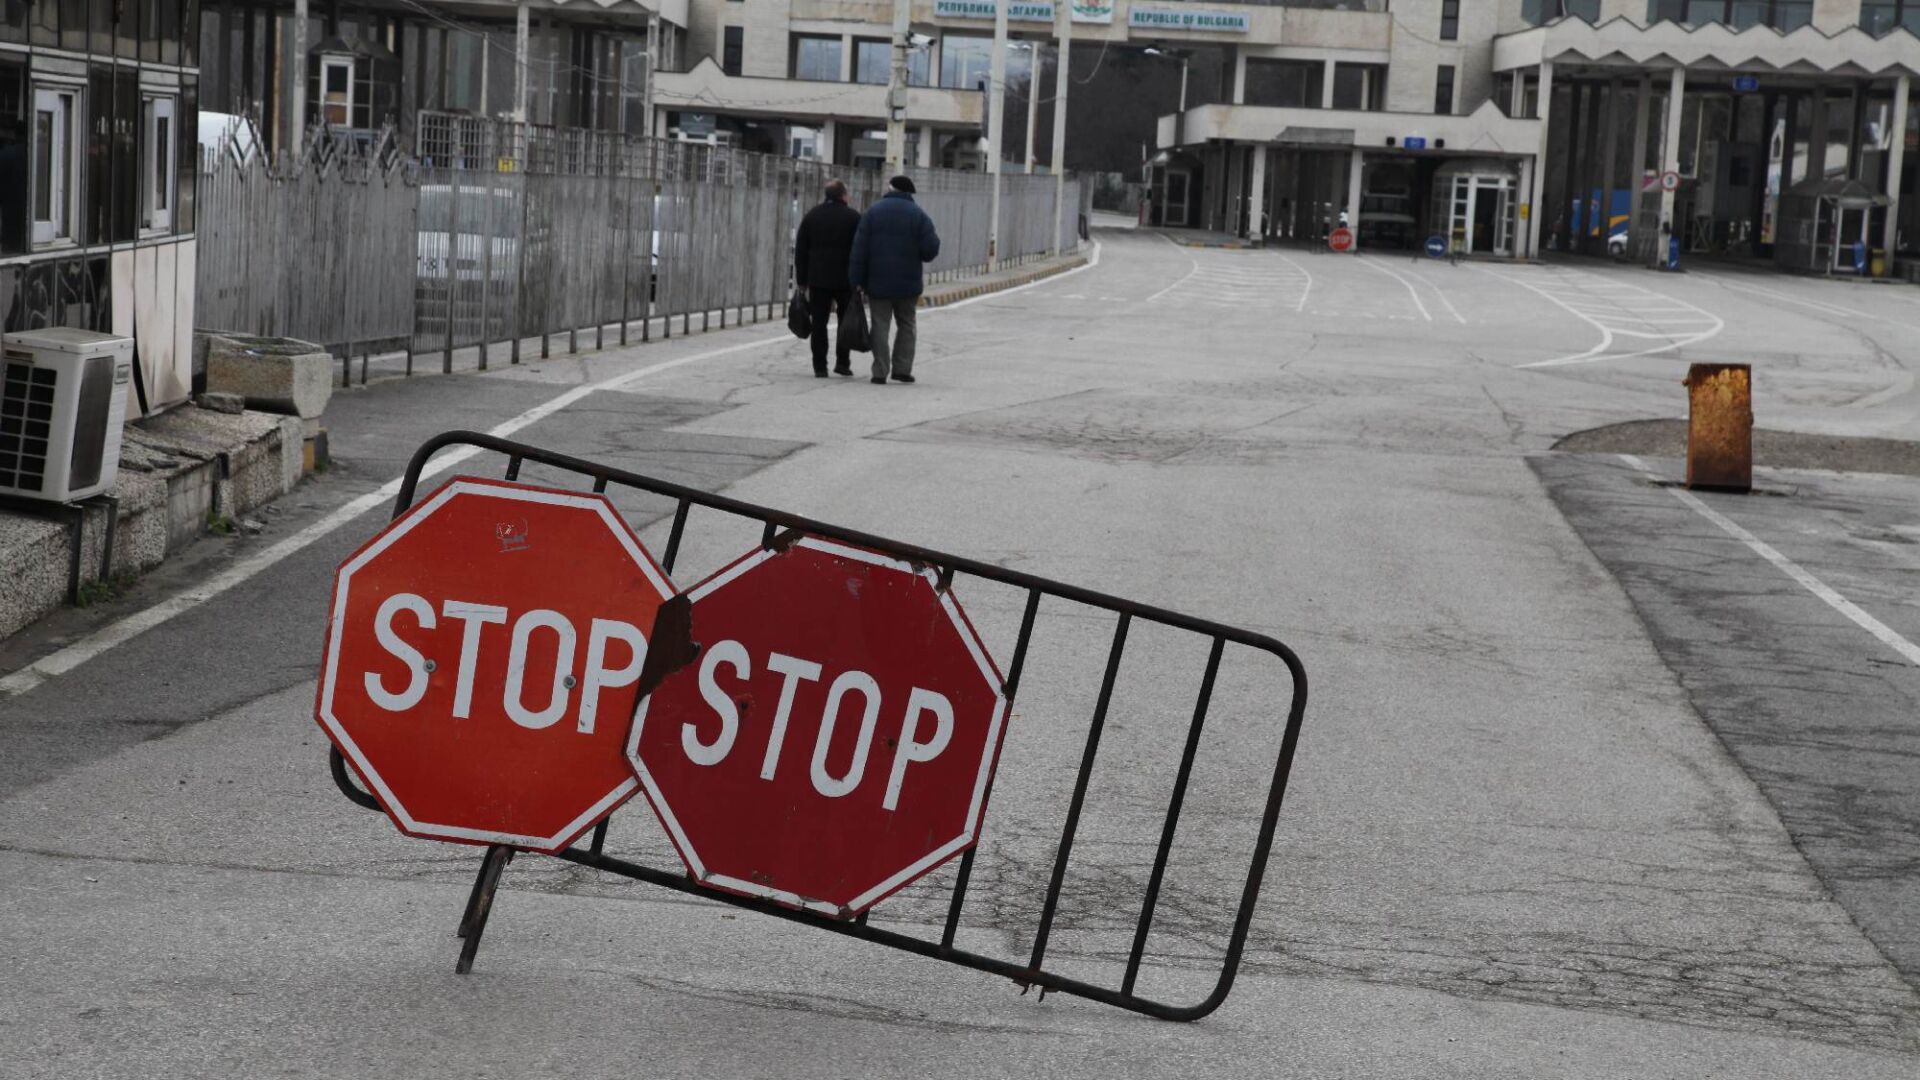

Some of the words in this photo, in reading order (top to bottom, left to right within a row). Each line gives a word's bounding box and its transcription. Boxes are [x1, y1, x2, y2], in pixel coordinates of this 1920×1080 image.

[937, 2, 996, 14] РЕПУБЛИКА
[1134, 12, 1180, 25] REPUBLIC
[1183, 15, 1194, 26] OF
[1198, 16, 1244, 29] BULGARIA
[364, 592, 649, 734] STOP
[680, 639, 955, 811] STOP
